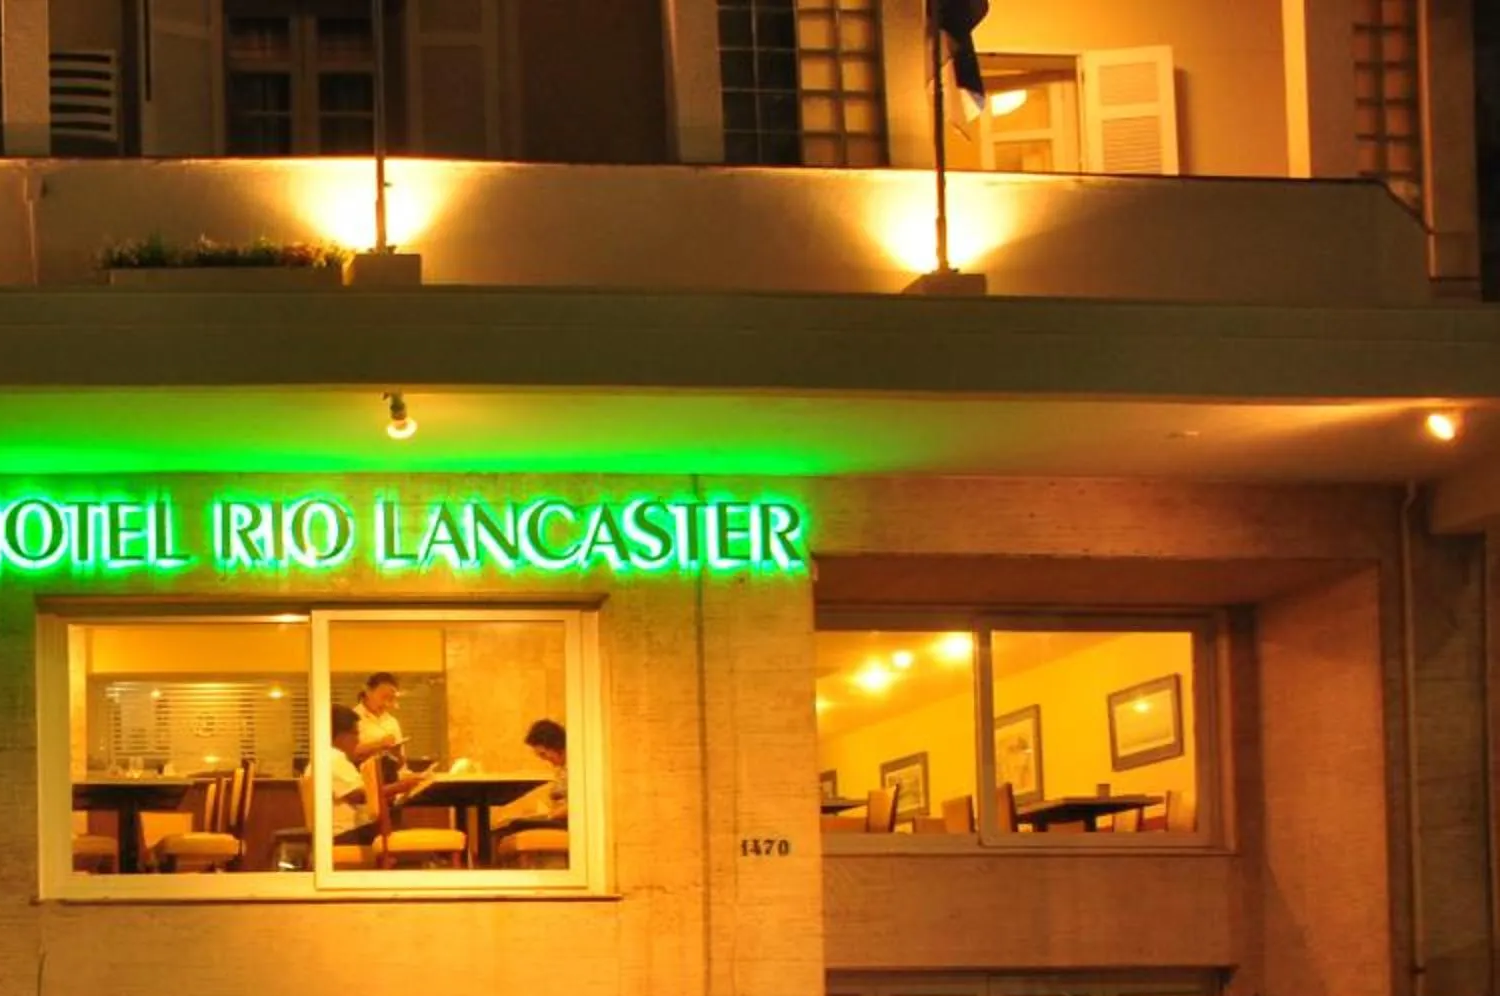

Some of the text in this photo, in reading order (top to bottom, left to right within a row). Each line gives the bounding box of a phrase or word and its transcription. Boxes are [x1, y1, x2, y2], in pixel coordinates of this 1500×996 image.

[220, 499, 350, 562] RIO
[381, 499, 801, 562] LANCASTER
[740, 838, 790, 857] 1470
